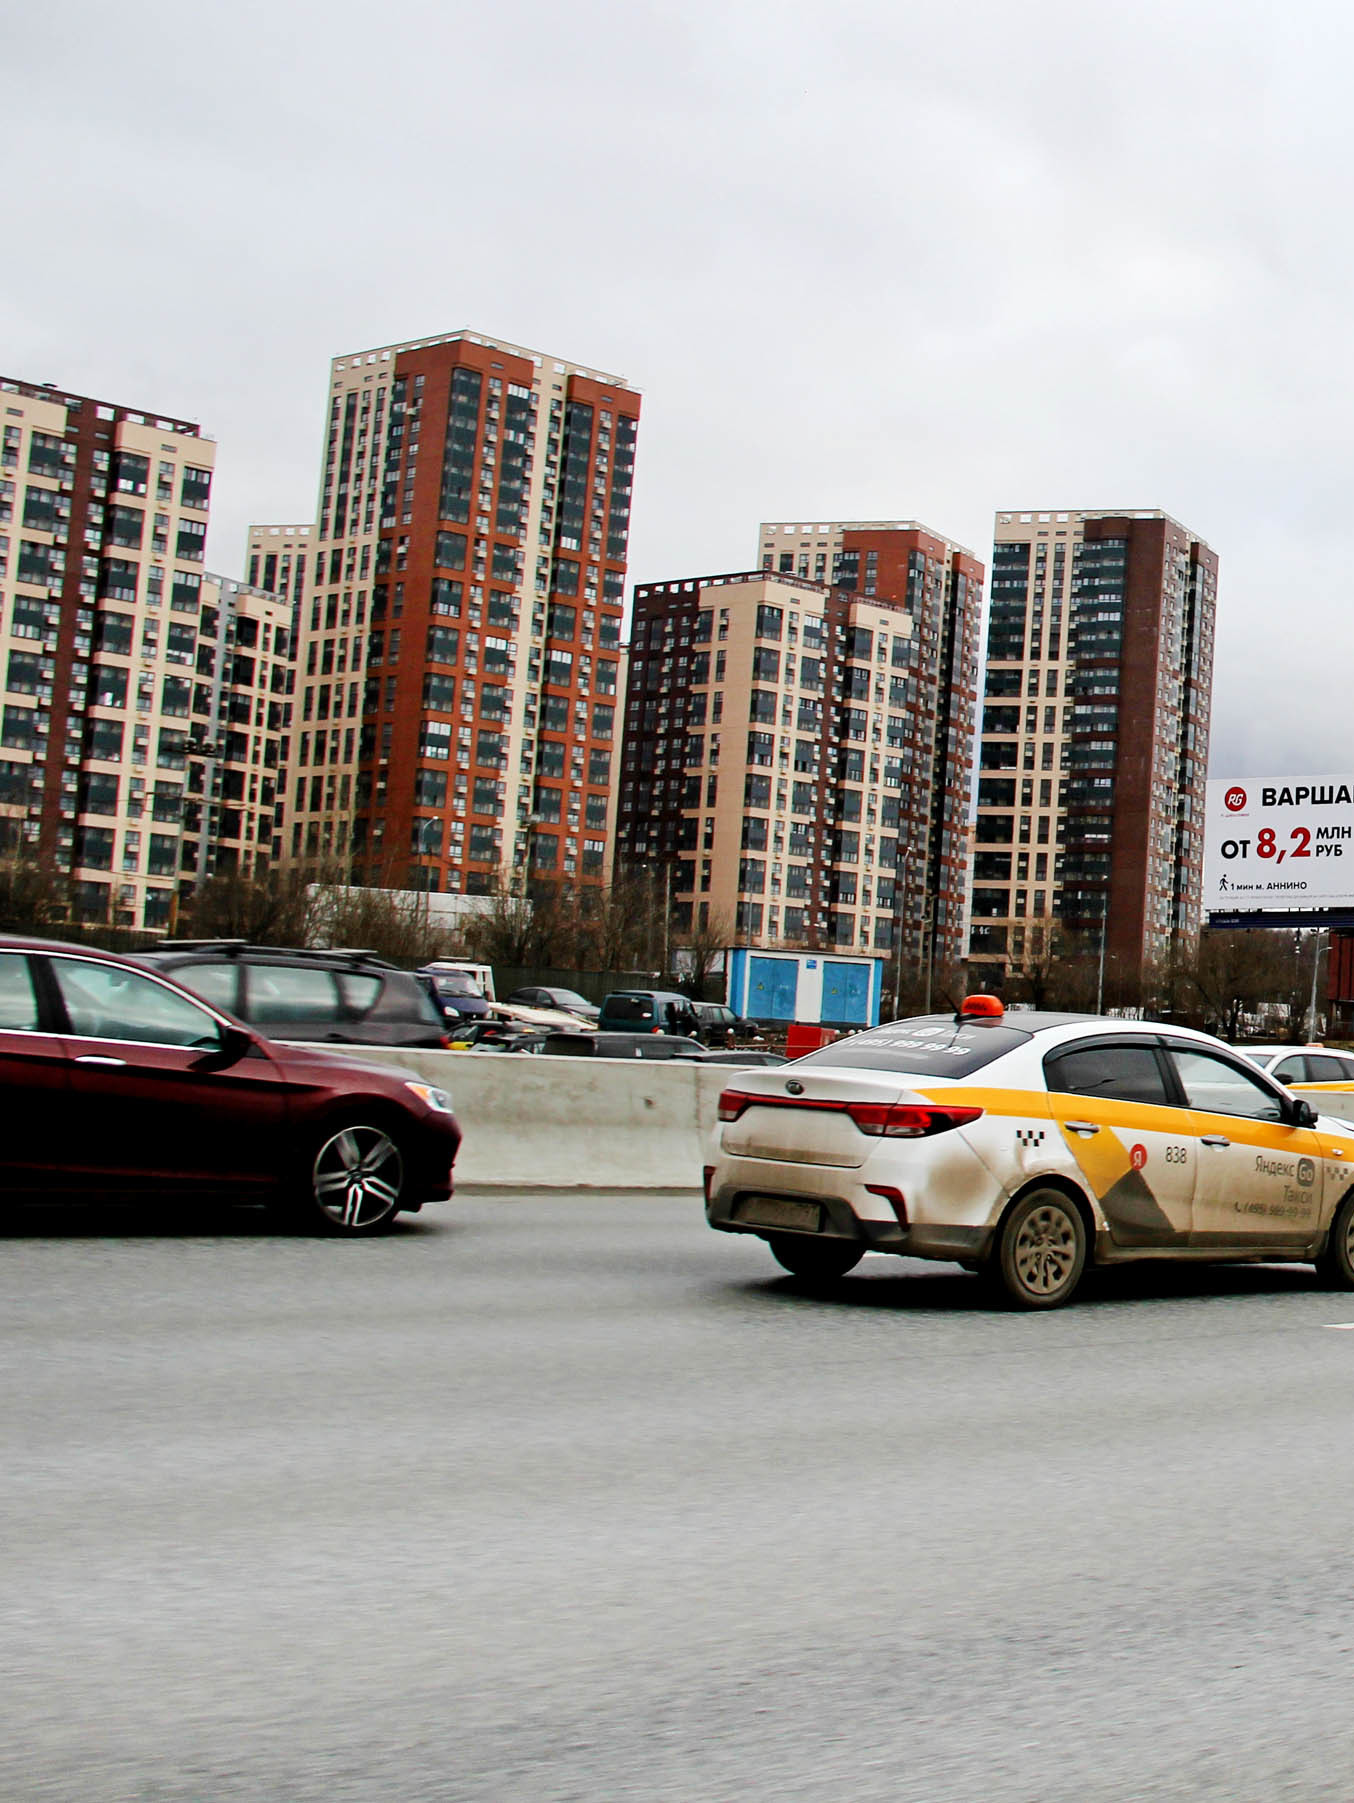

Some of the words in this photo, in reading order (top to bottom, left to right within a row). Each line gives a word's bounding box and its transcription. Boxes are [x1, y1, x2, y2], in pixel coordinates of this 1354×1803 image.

[1227, 793, 1244, 806] RG
[1316, 826, 1352, 840] МЛН
[1221, 840, 1251, 859] ОТ
[1256, 827, 1311, 864] 8,2
[1316, 844, 1343, 857] РУБ
[1266, 881, 1308, 890] АННИНО
[1165, 1146, 1187, 1164] 838
[1255, 1155, 1295, 1177] Яндекс
